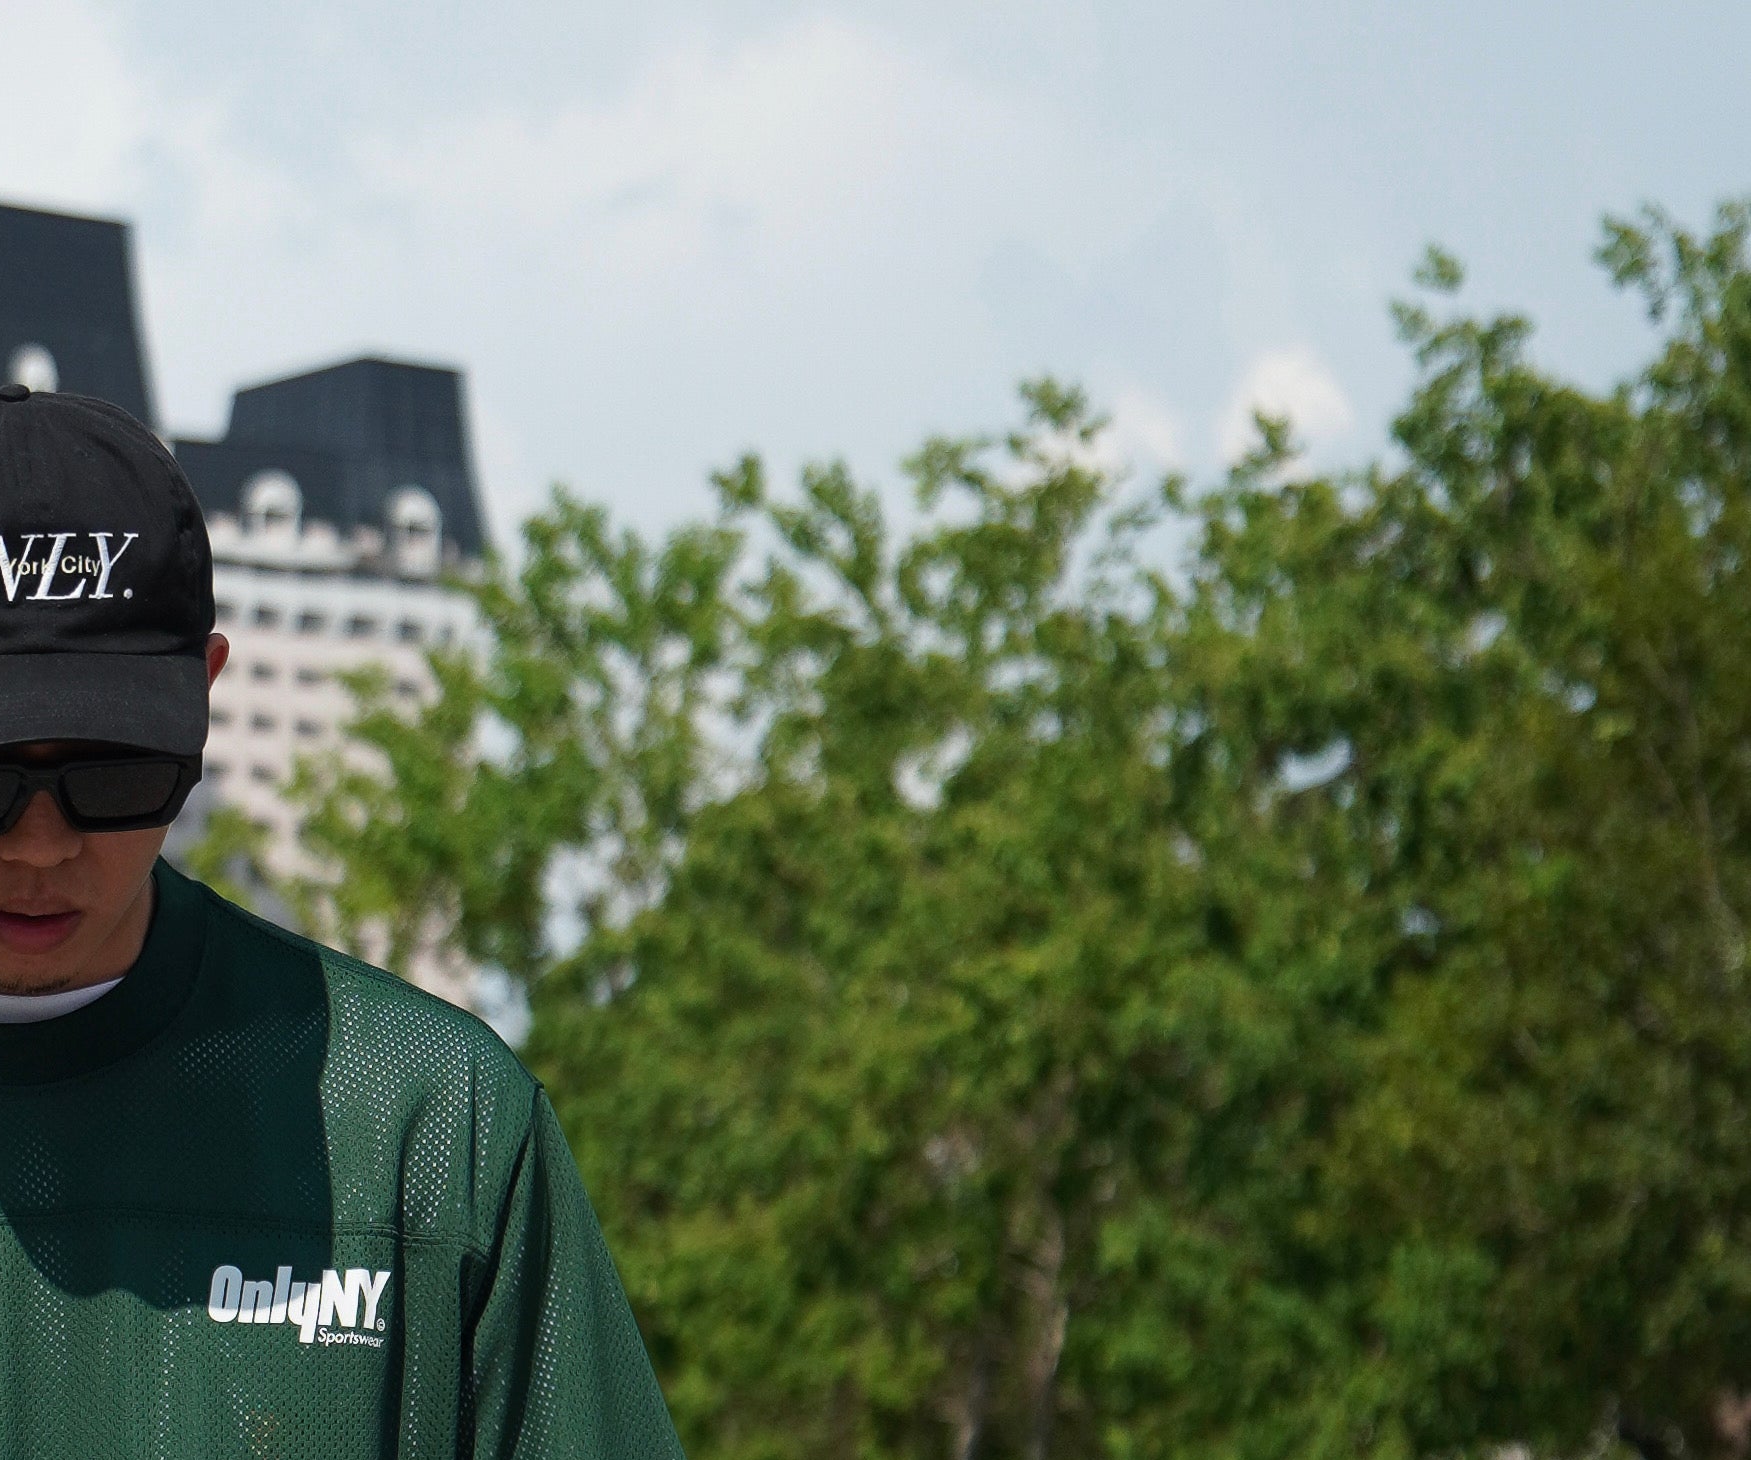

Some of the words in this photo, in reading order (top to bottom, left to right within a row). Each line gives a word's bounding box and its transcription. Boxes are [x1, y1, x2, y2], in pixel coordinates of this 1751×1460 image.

[61, 555, 101, 577] City
[208, 1265, 391, 1343] OnlyNY
[317, 1327, 385, 1348] Sportswear
